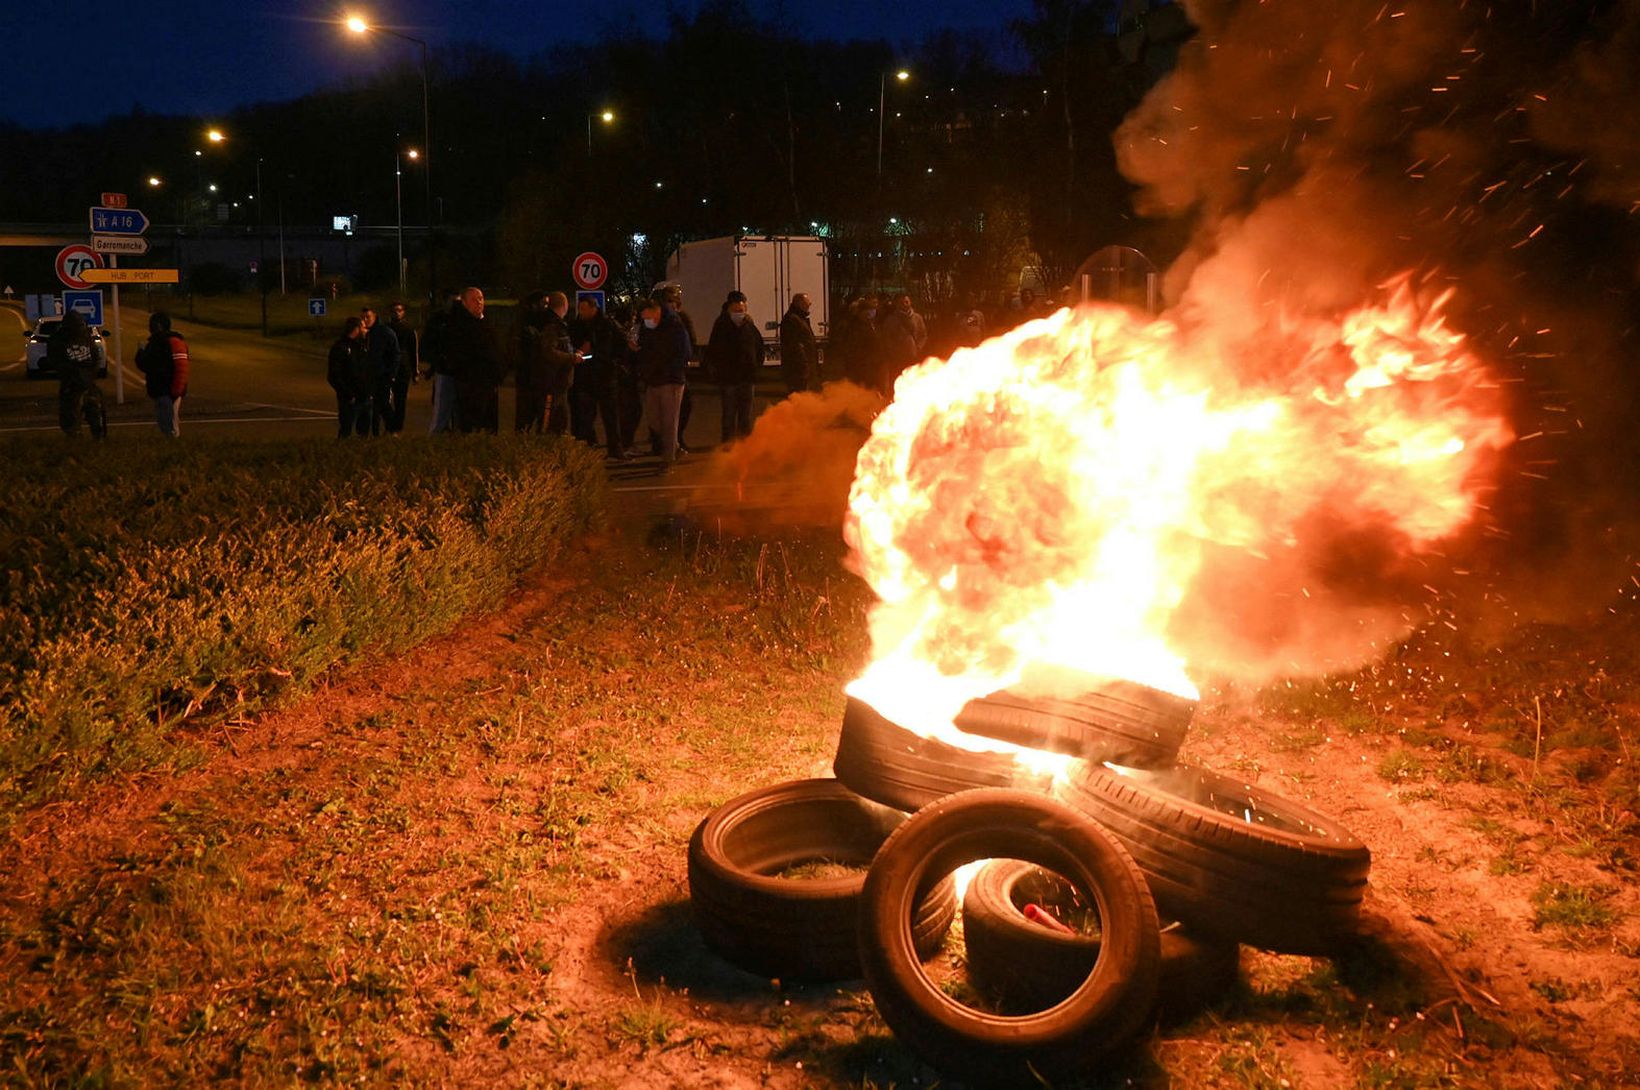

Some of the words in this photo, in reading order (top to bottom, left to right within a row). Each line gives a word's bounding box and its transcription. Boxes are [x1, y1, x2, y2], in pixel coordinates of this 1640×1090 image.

[122, 216, 133, 228] 16
[111, 271, 127, 280] HUB
[133, 271, 155, 280] PORT
[582, 264, 600, 279] 70
